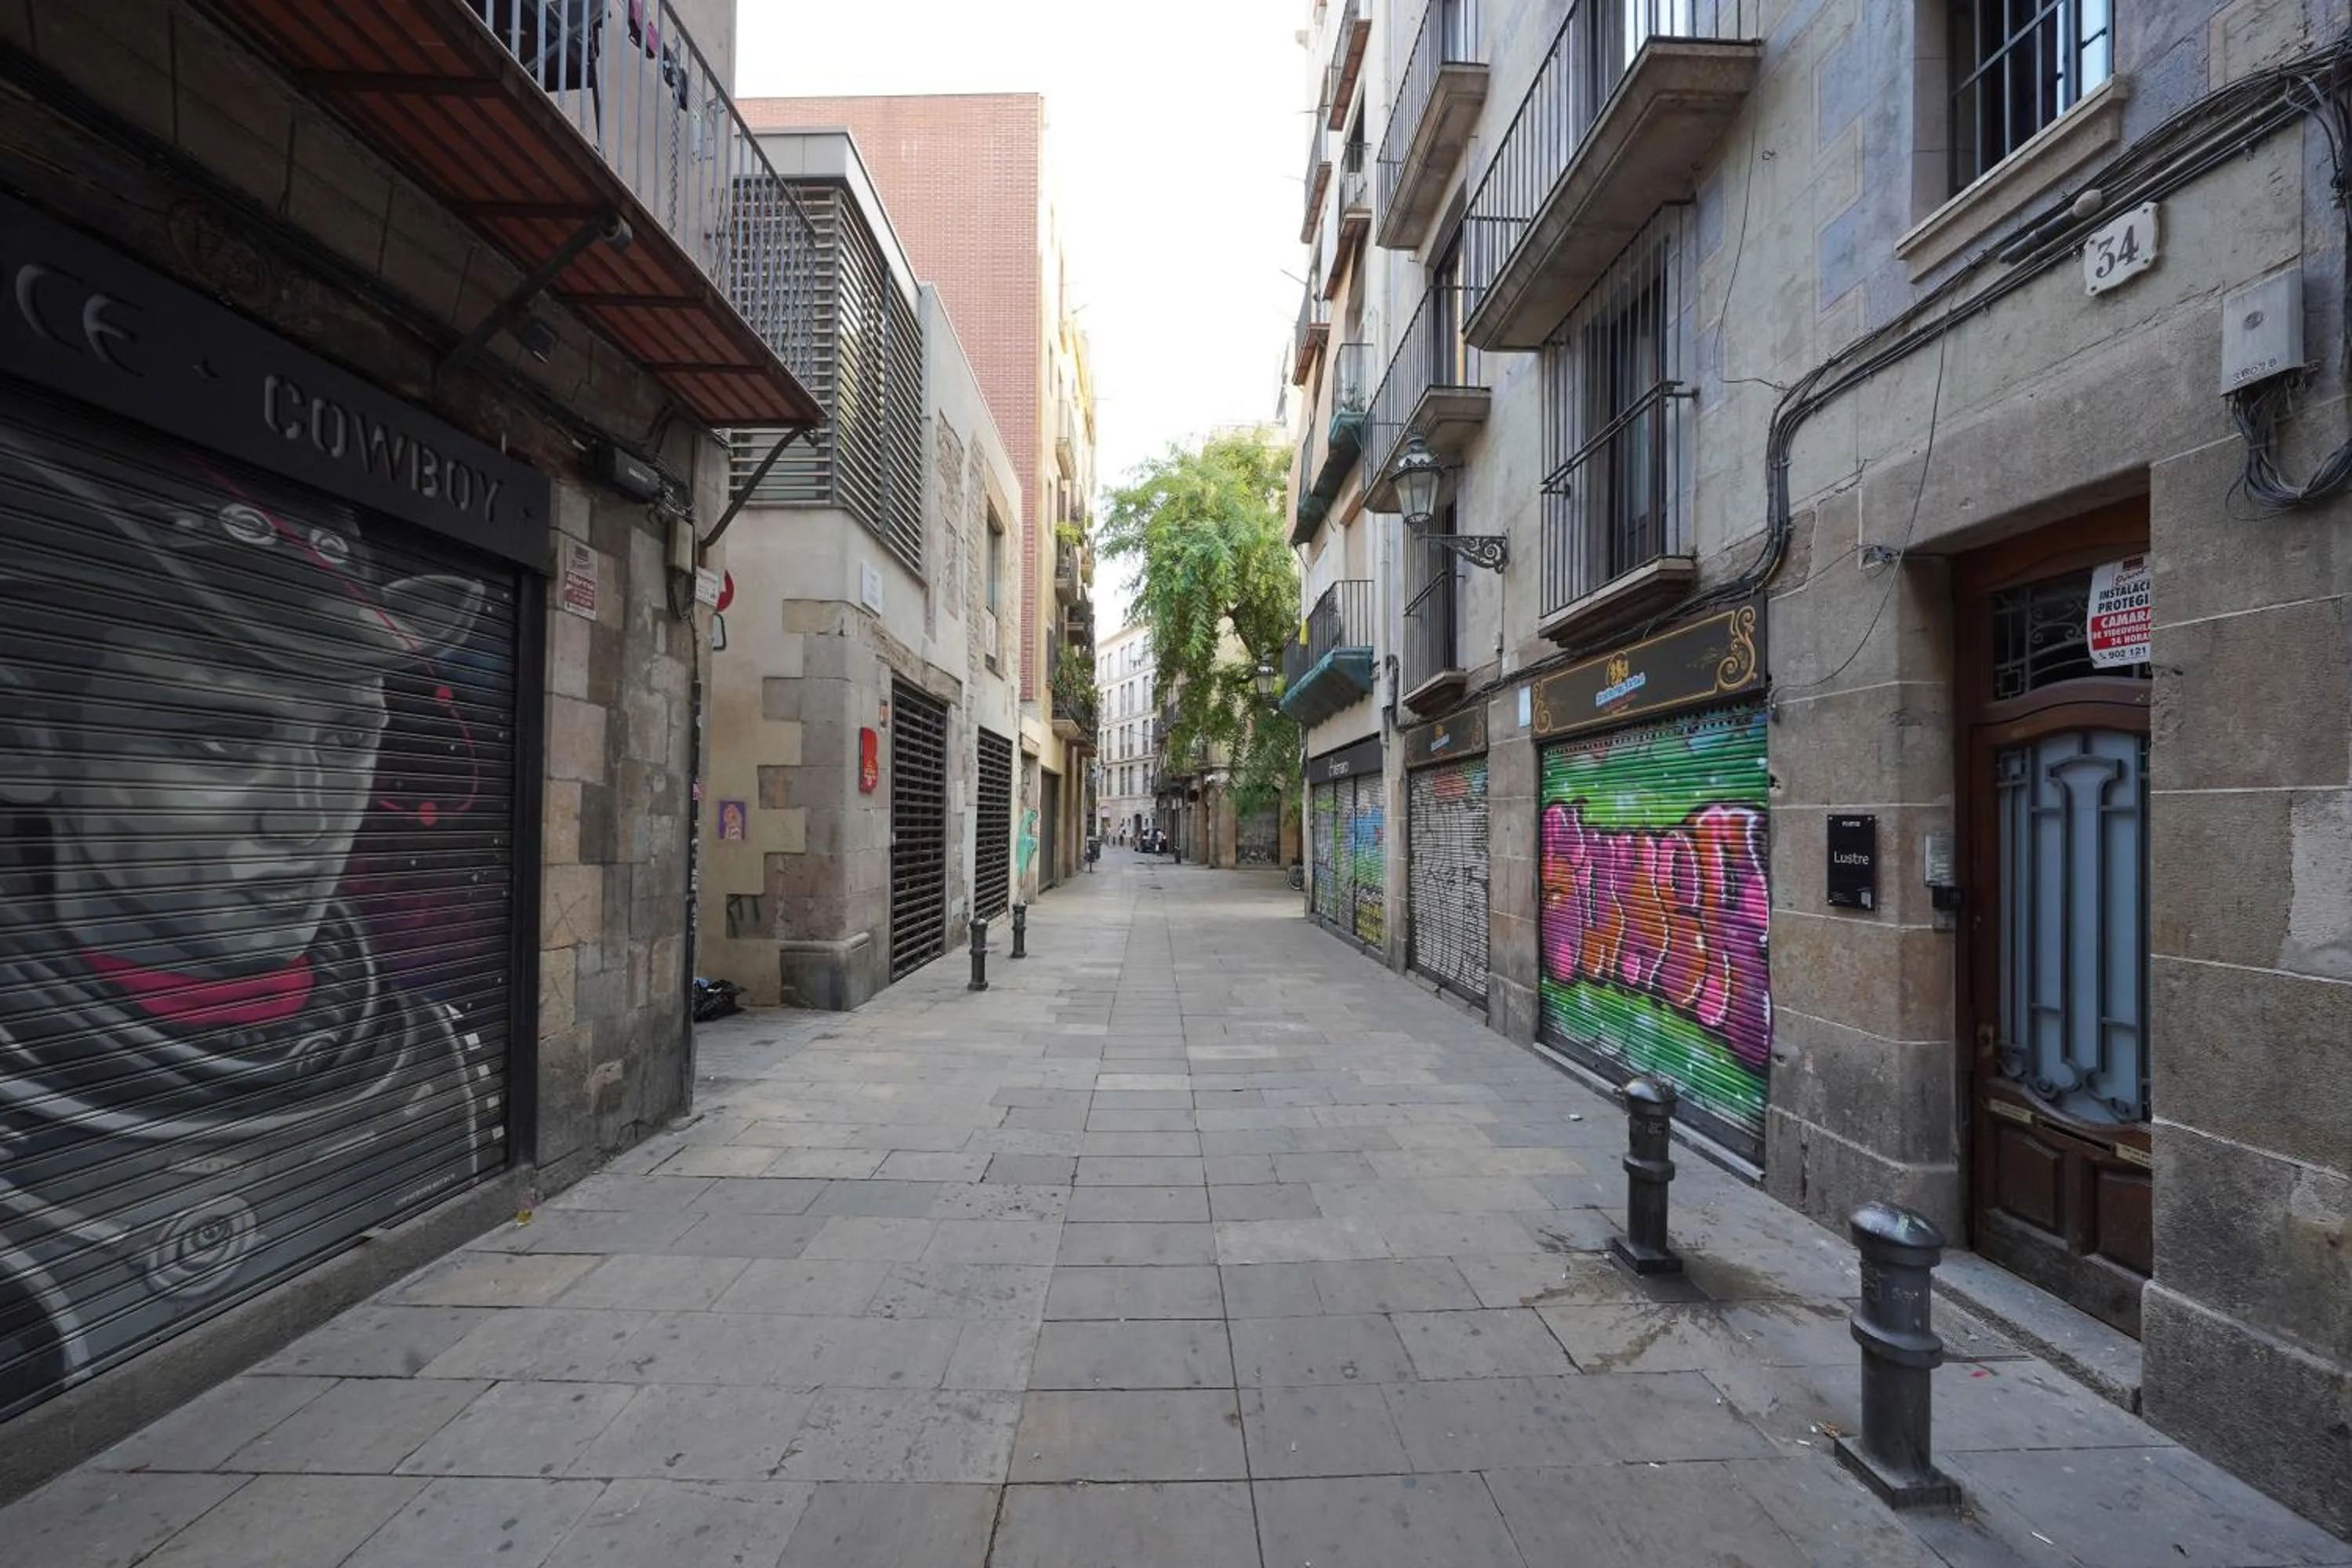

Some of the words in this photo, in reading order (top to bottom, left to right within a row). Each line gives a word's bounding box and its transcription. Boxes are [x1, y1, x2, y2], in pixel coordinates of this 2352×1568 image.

[2095, 224, 2140, 278] 34
[0, 260, 146, 378] CE
[263, 374, 505, 523] COWBOY
[2097, 593, 2149, 614] PROTEGI
[2108, 648, 2126, 659] 902
[2129, 645, 2147, 657] 121
[1833, 850, 1870, 866] Lustre
